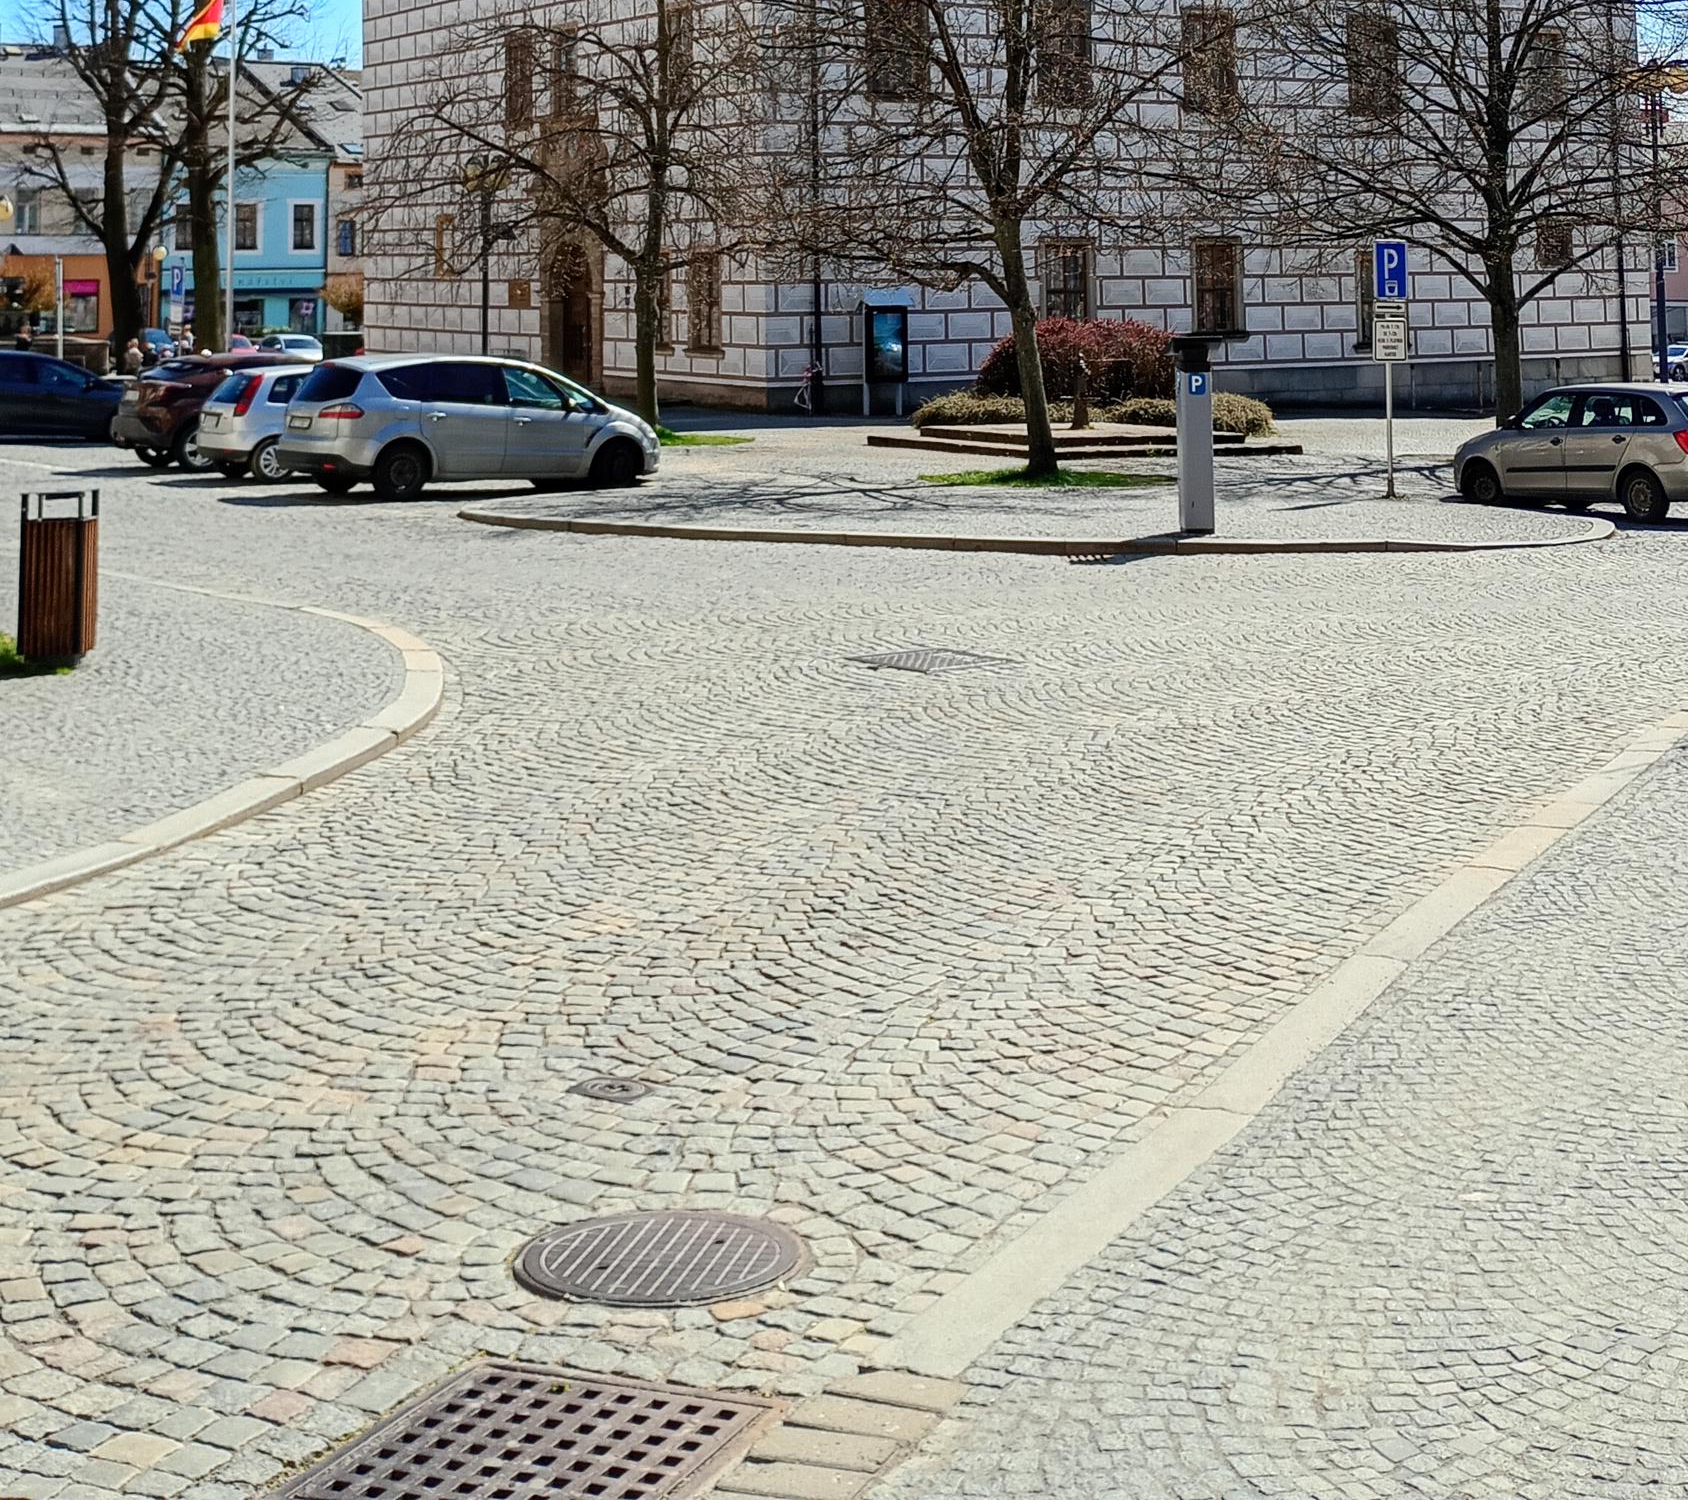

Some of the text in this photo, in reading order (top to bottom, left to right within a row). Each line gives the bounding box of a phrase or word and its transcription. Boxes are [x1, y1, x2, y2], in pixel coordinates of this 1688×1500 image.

[1384, 248, 1398, 279] P
[173, 269, 181, 291] P
[1191, 376, 1203, 392] P
